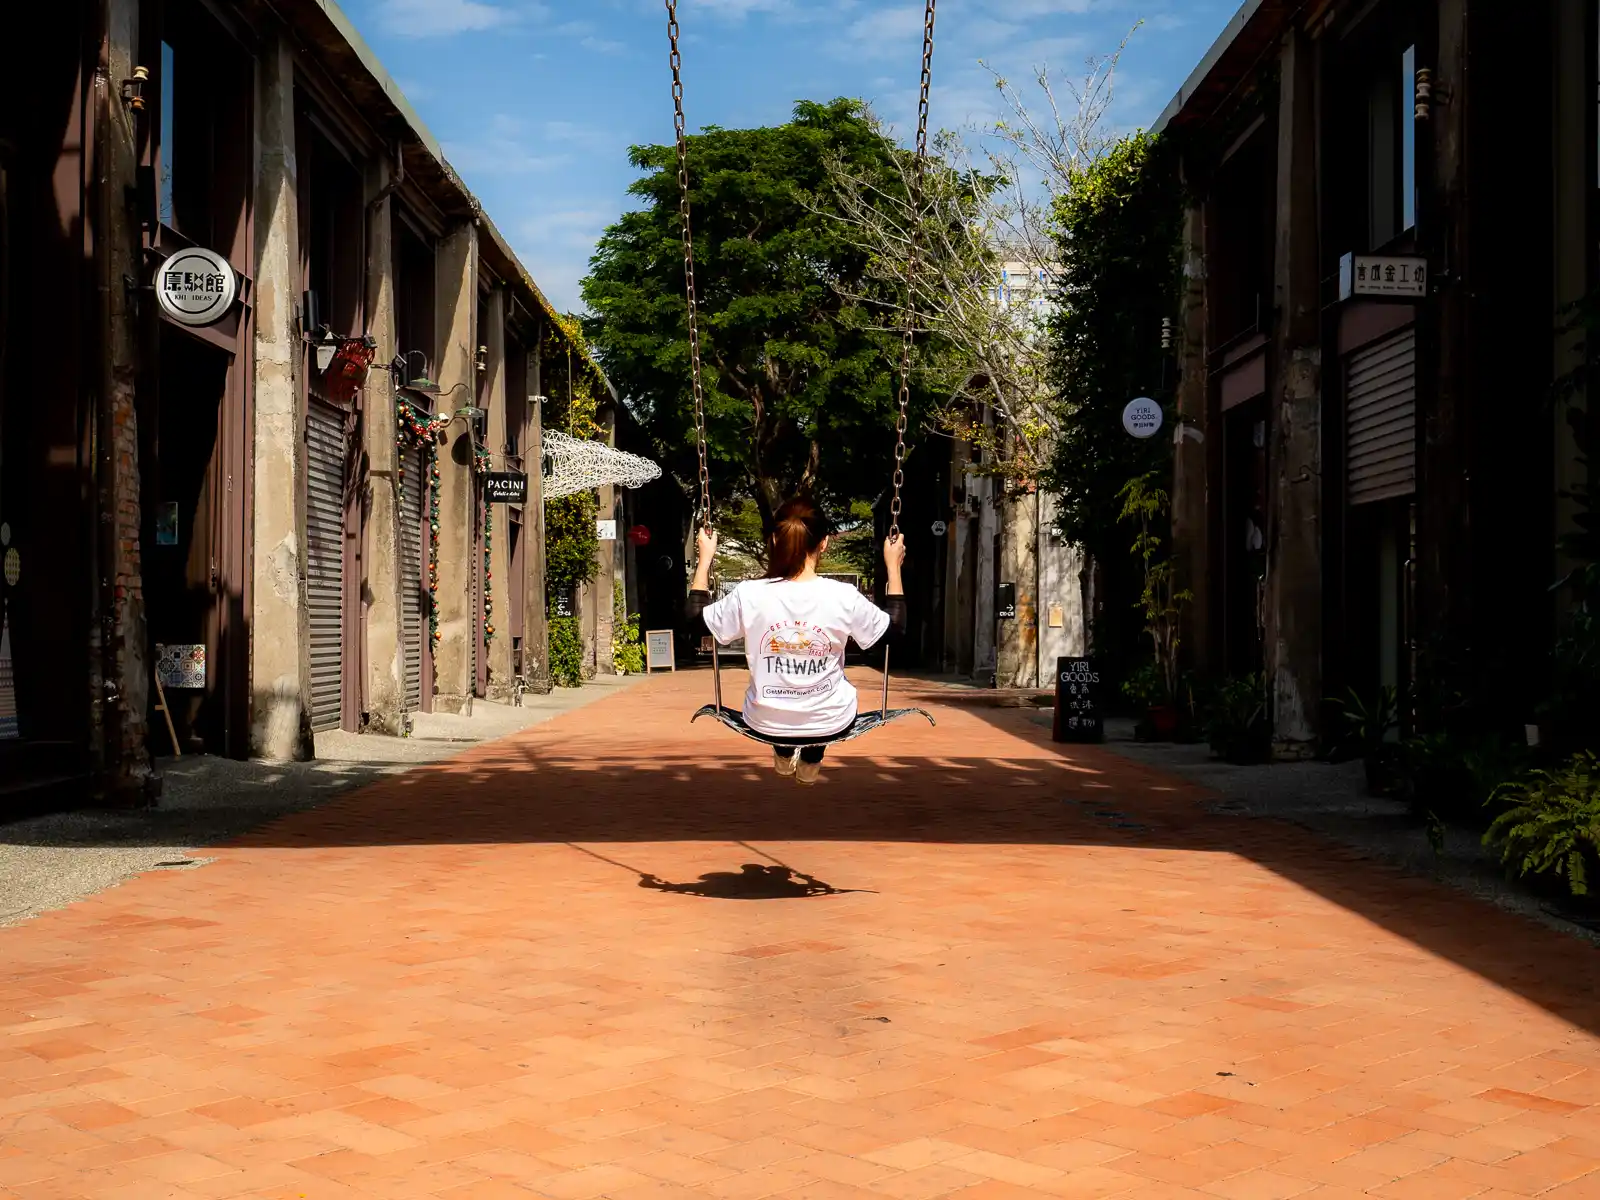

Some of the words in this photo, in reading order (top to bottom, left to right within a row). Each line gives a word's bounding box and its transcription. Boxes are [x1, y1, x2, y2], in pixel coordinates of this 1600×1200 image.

[192, 294, 213, 302] IDEAS
[1130, 413, 1156, 421] GOODS
[487, 480, 524, 490] PACINI
[769, 620, 788, 632] GET
[794, 620, 808, 628] ME
[763, 655, 828, 676] TAIWAN
[1069, 661, 1090, 672] YIRI
[1060, 671, 1100, 684] GOODS
